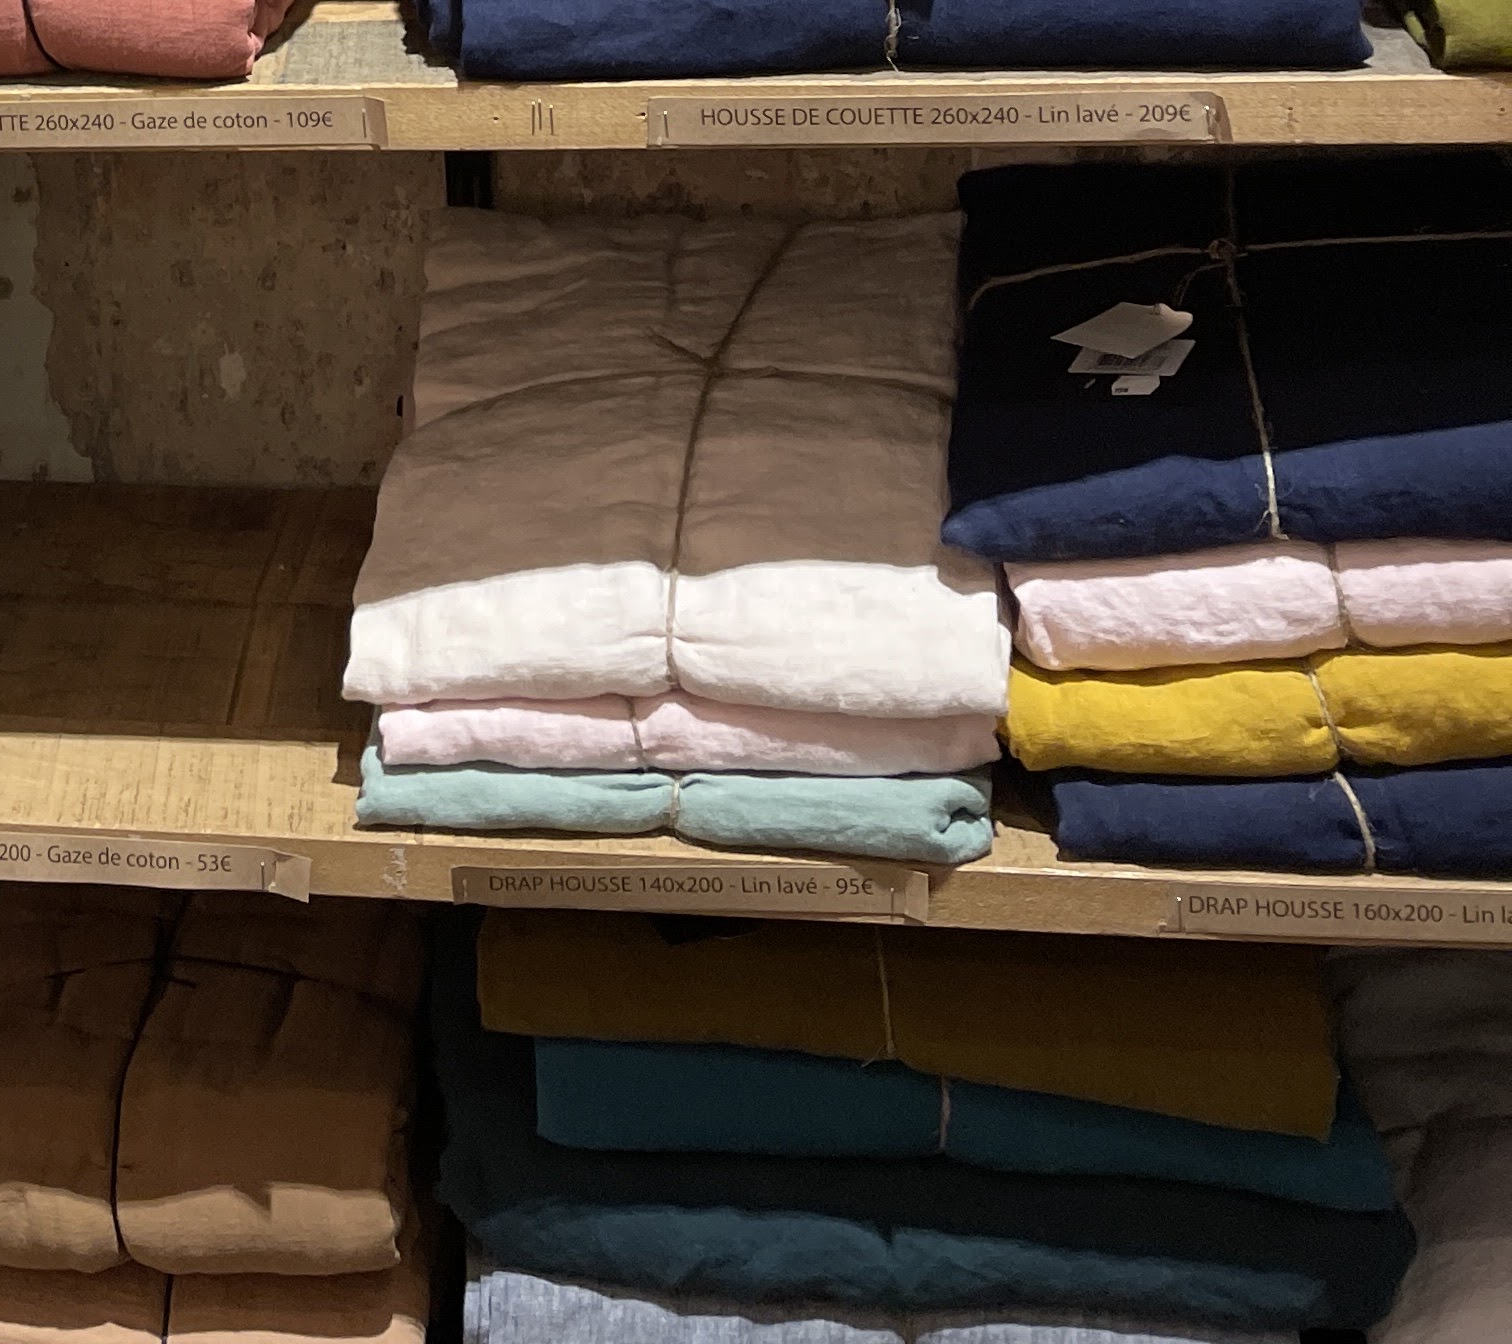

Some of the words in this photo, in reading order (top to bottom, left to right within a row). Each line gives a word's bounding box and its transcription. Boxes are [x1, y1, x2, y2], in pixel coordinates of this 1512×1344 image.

[35, 113, 114, 131] 260x240
[131, 112, 178, 130] Gaze
[183, 110, 207, 130] de
[212, 112, 267, 129] coton
[286, 110, 333, 128] 109€
[701, 108, 786, 127] HOUSSE
[792, 108, 820, 126] DE
[826, 107, 924, 126] COUETTE
[930, 106, 1019, 125] 260x240
[1038, 106, 1069, 124] Lin
[1076, 103, 1119, 123] lavé
[1138, 104, 1192, 123] 209€
[47, 844, 93, 865] Gaze
[98, 846, 121, 867] de
[126, 852, 179, 870] coton
[197, 853, 231, 873] 53€
[489, 873, 544, 892] DRAP
[550, 875, 632, 893] HOUSSE
[639, 876, 723, 894] 140x200
[741, 876, 771, 894] Lin
[777, 875, 817, 895] lavé
[836, 877, 874, 896] 95€
[1188, 895, 1248, 916] DRAP
[1255, 899, 1345, 920] HOUSSE
[1352, 902, 1443, 923] 160x200
[1462, 905, 1495, 924] Lin
